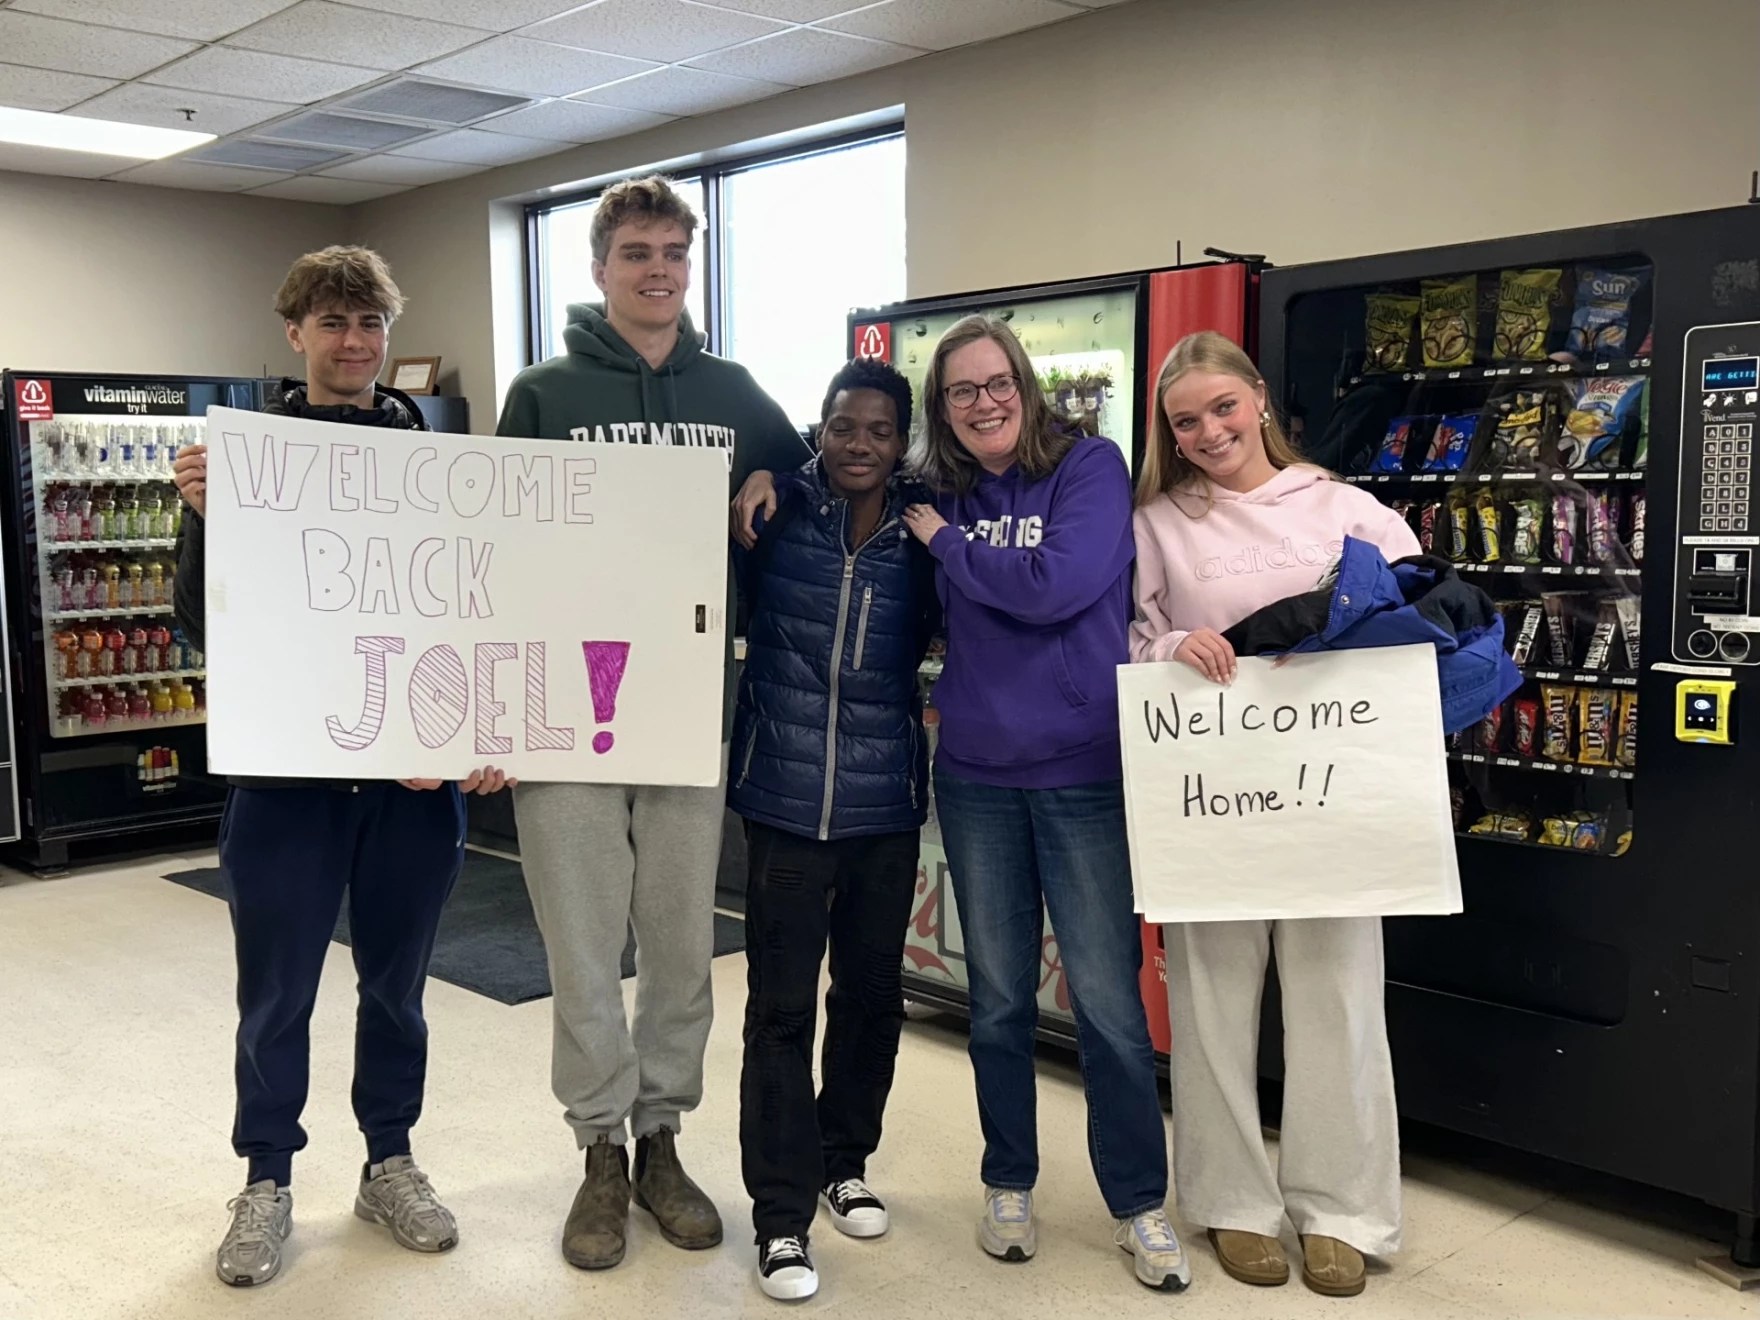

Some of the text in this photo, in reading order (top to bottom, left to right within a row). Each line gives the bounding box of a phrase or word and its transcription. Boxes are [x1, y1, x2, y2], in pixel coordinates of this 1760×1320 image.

[83, 385, 185, 404] vitaminwater
[127, 403, 147, 414] try it
[222, 431, 597, 524] WELCOME
[302, 528, 494, 618] BACK
[325, 636, 632, 754] JOEL!
[1144, 691, 1379, 743] Welcome
[1183, 763, 1334, 817] Home!!
